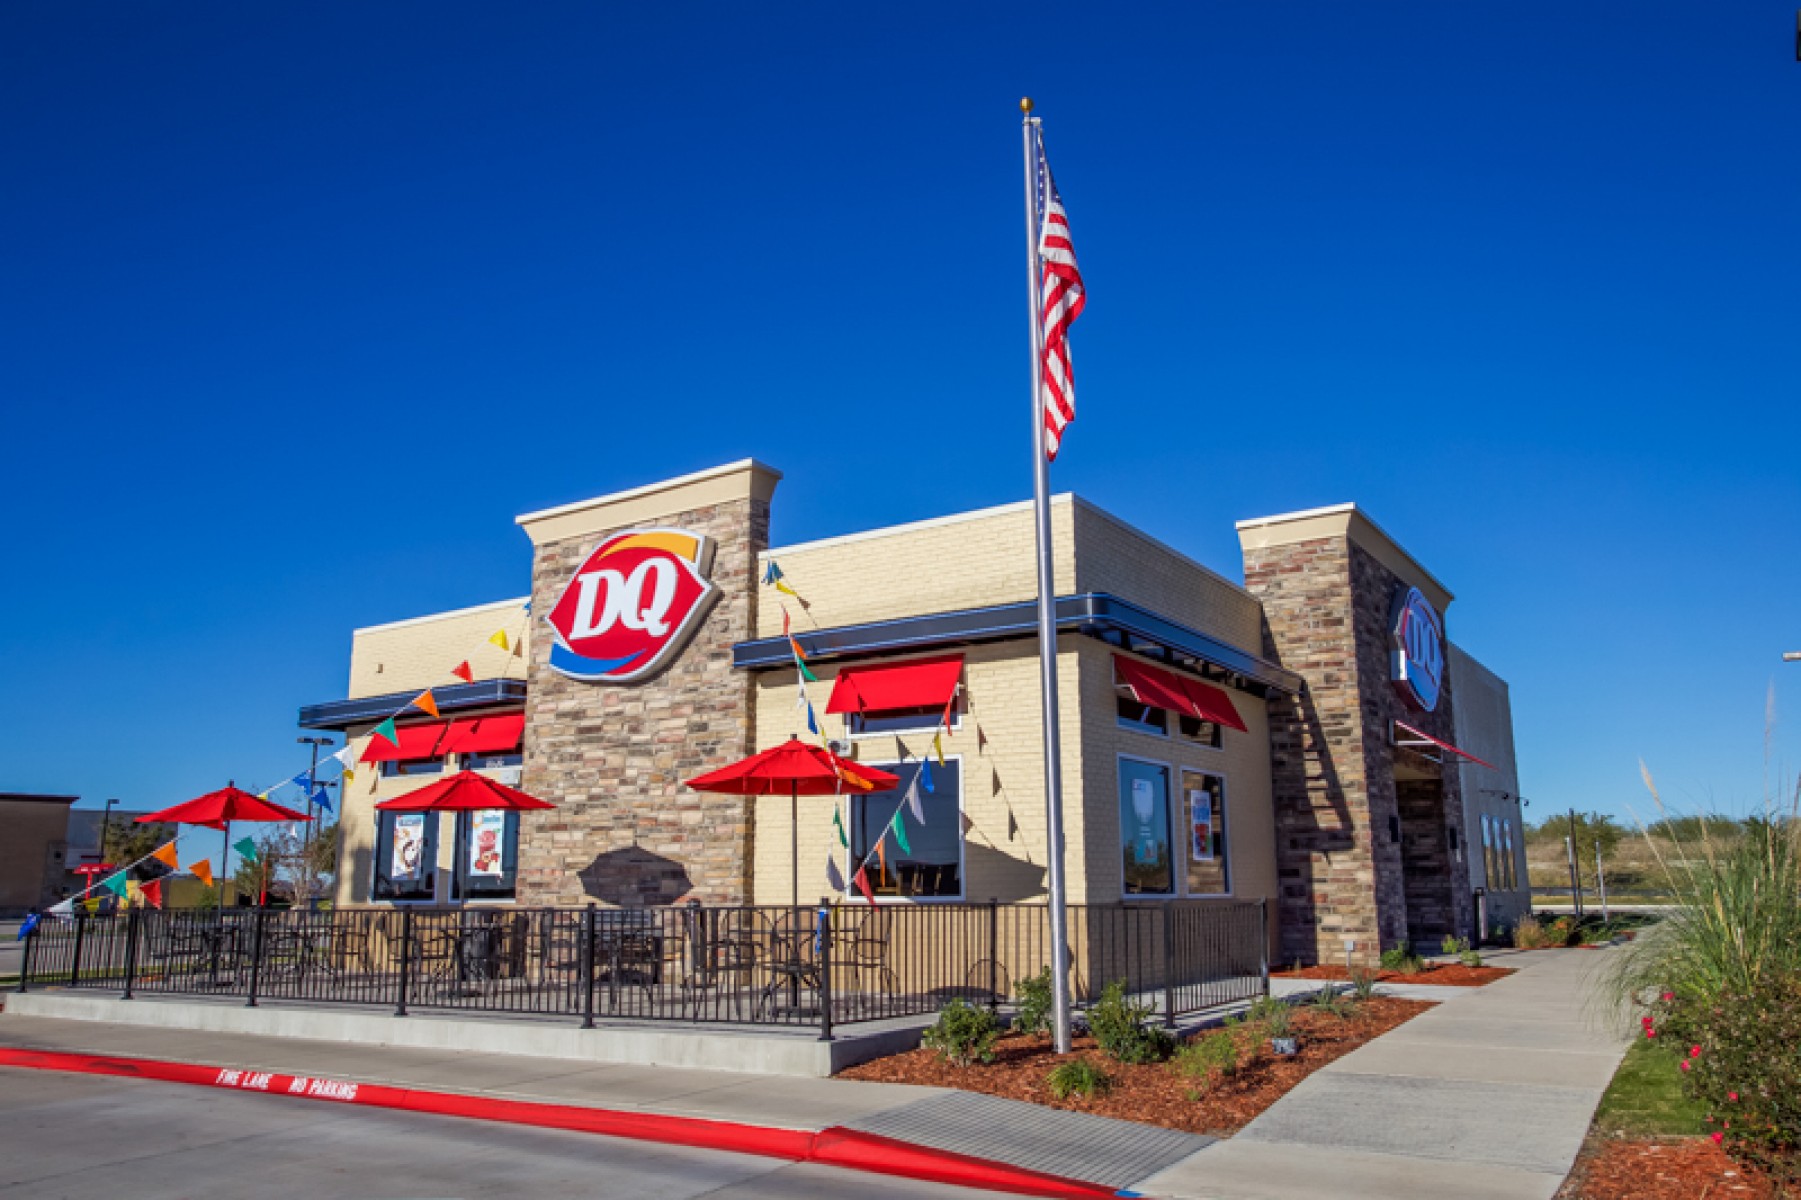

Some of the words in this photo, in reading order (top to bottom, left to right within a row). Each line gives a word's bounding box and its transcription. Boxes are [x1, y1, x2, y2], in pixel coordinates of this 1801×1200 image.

[568, 556, 678, 640] DQ
[1408, 608, 1438, 687] DQ
[242, 1071, 273, 1090] LANE
[288, 1075, 307, 1093] NO
[308, 1077, 359, 1100] PARKING
